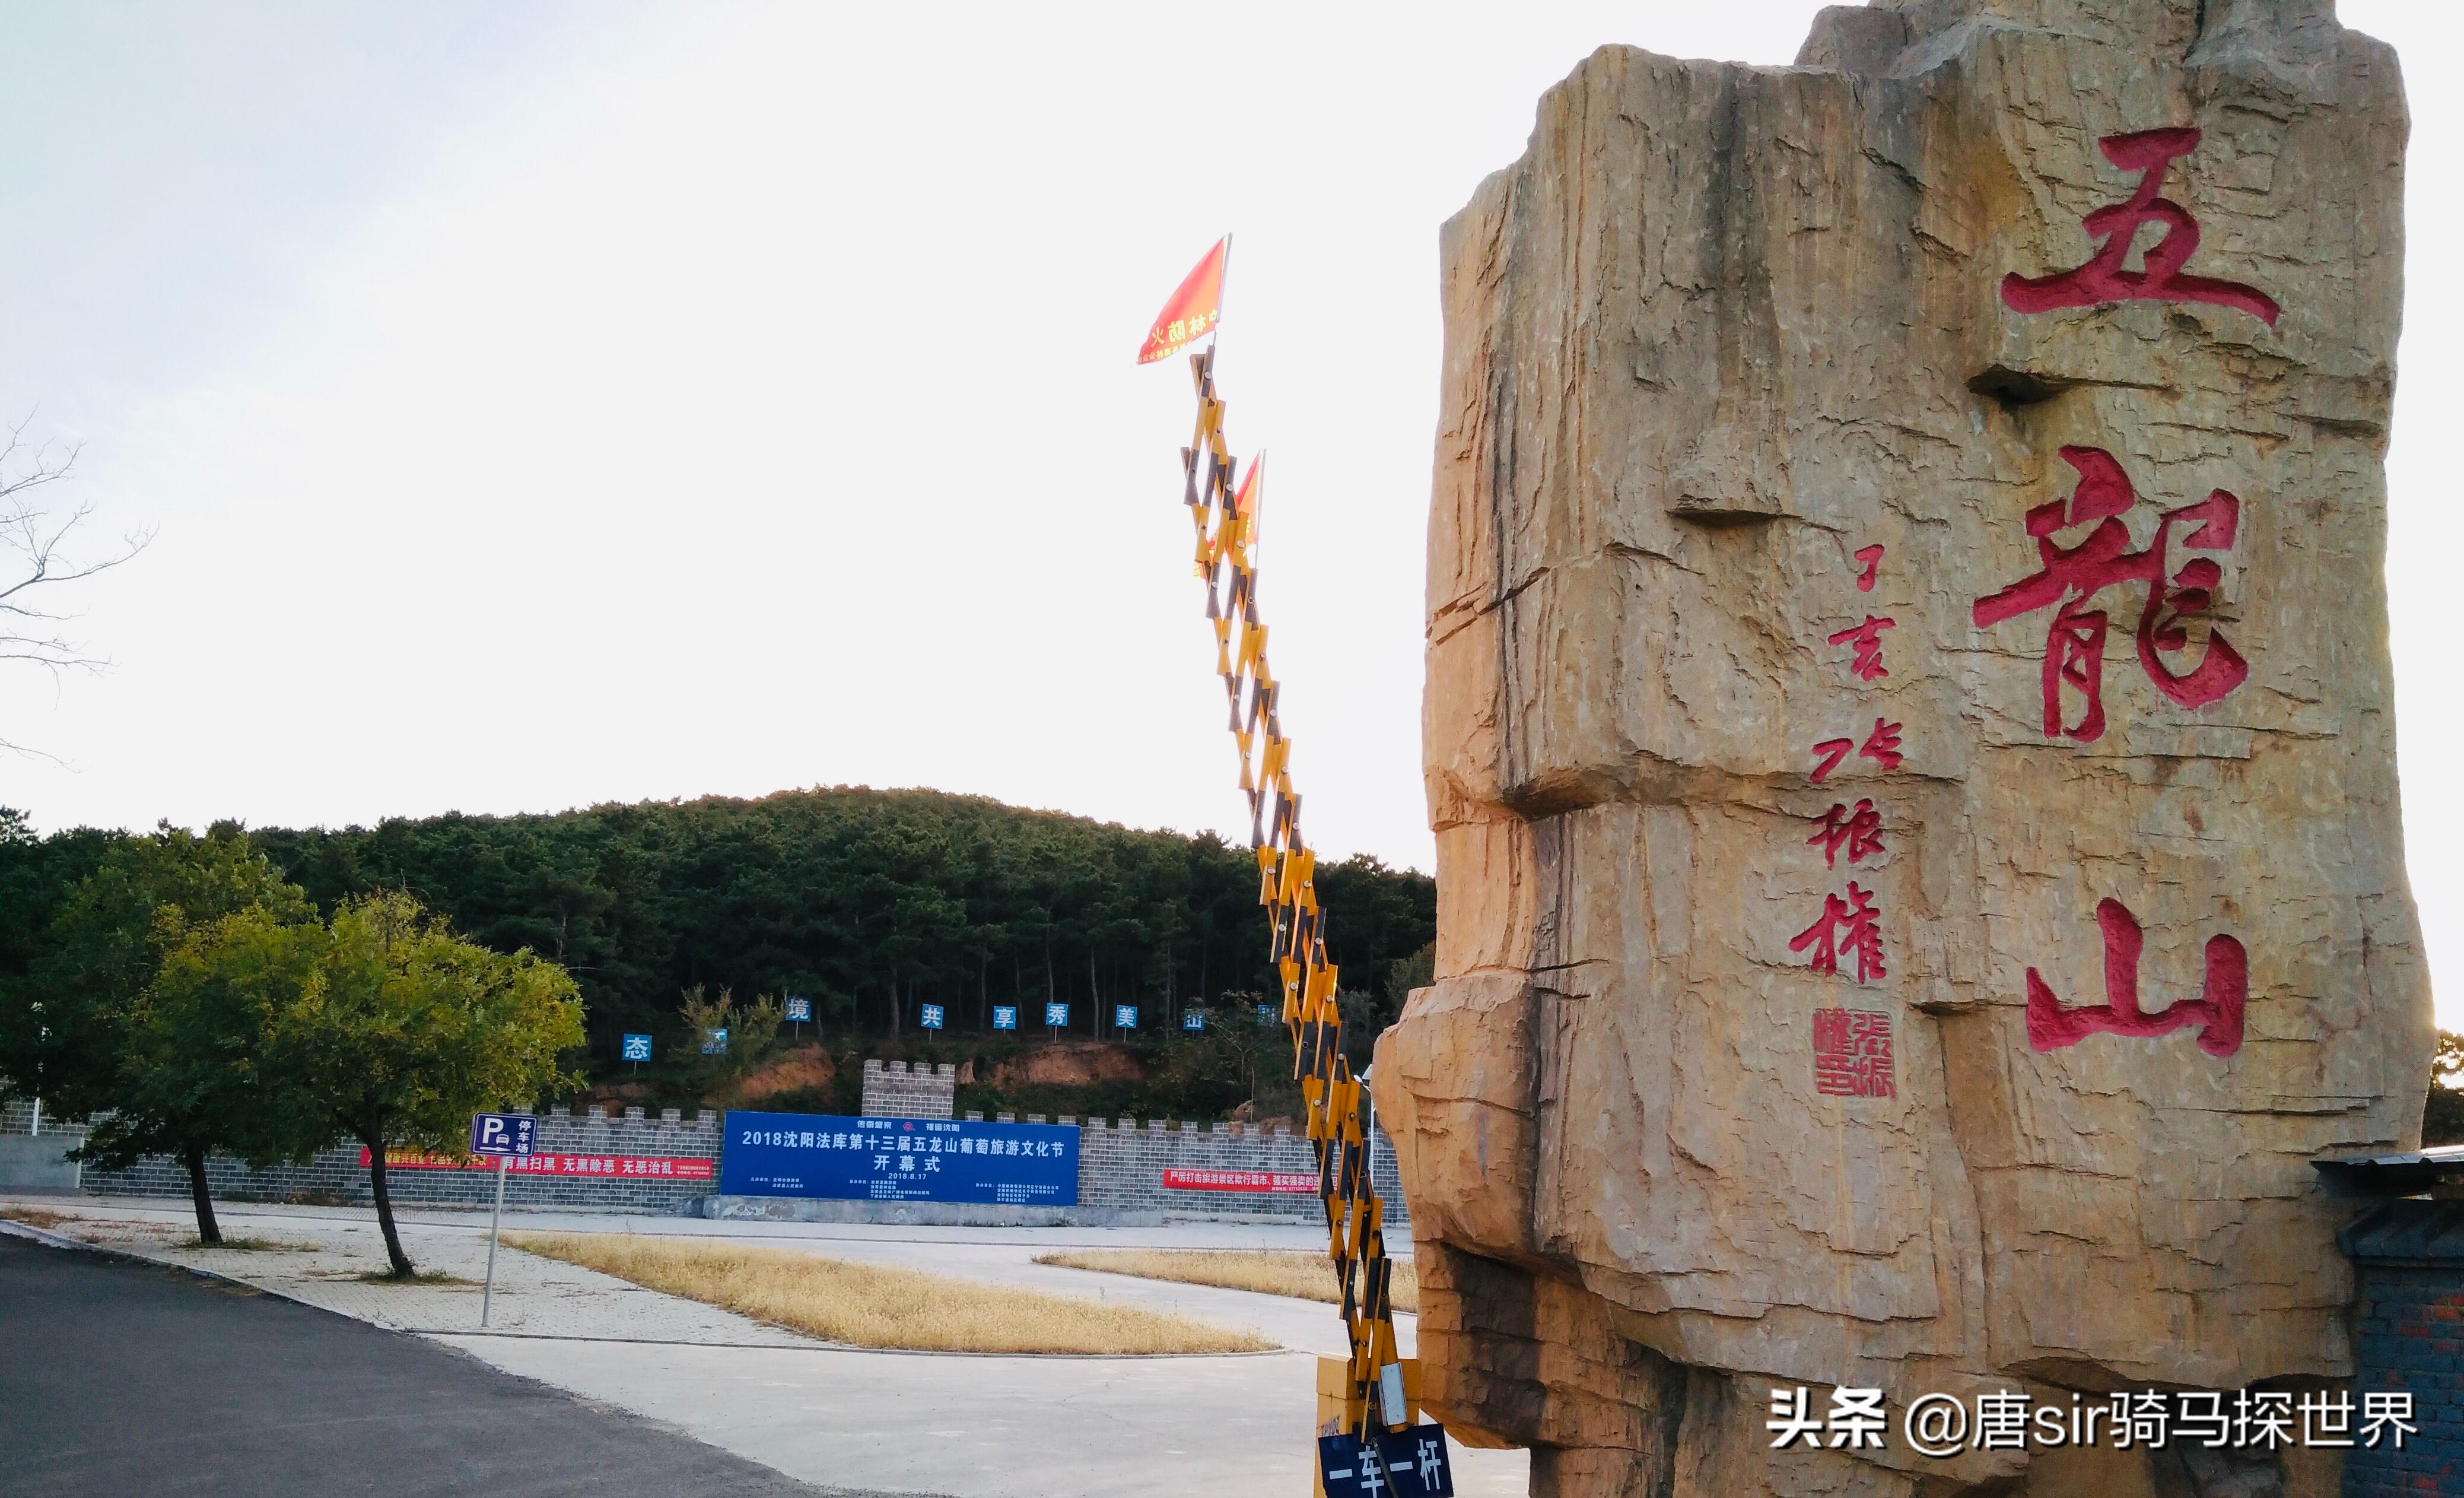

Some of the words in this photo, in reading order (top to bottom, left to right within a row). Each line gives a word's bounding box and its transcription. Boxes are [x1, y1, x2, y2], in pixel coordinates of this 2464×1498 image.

[788, 998, 809, 1019] 境
[923, 1007, 941, 1026] 共
[996, 1008, 1015, 1027] 享
[1048, 1005, 1066, 1024] 秀
[1118, 1008, 1134, 1027] 美
[625, 1037, 648, 1059] 态
[482, 1118, 504, 1144] P
[857, 1120, 892, 1129] 传奇盛京
[926, 1123, 960, 1132] 福运沈阳
[516, 1120, 532, 1154] 停车场
[742, 1131, 1064, 1157] 2018沈阳法库第十三届五龙山葡萄旅游文化节
[563, 1158, 615, 1173] 无黑除恶
[622, 1160, 673, 1175] 无恶治乱
[874, 1155, 940, 1172] 开幕式
[1329, 1439, 1441, 1498] 一车一杆
